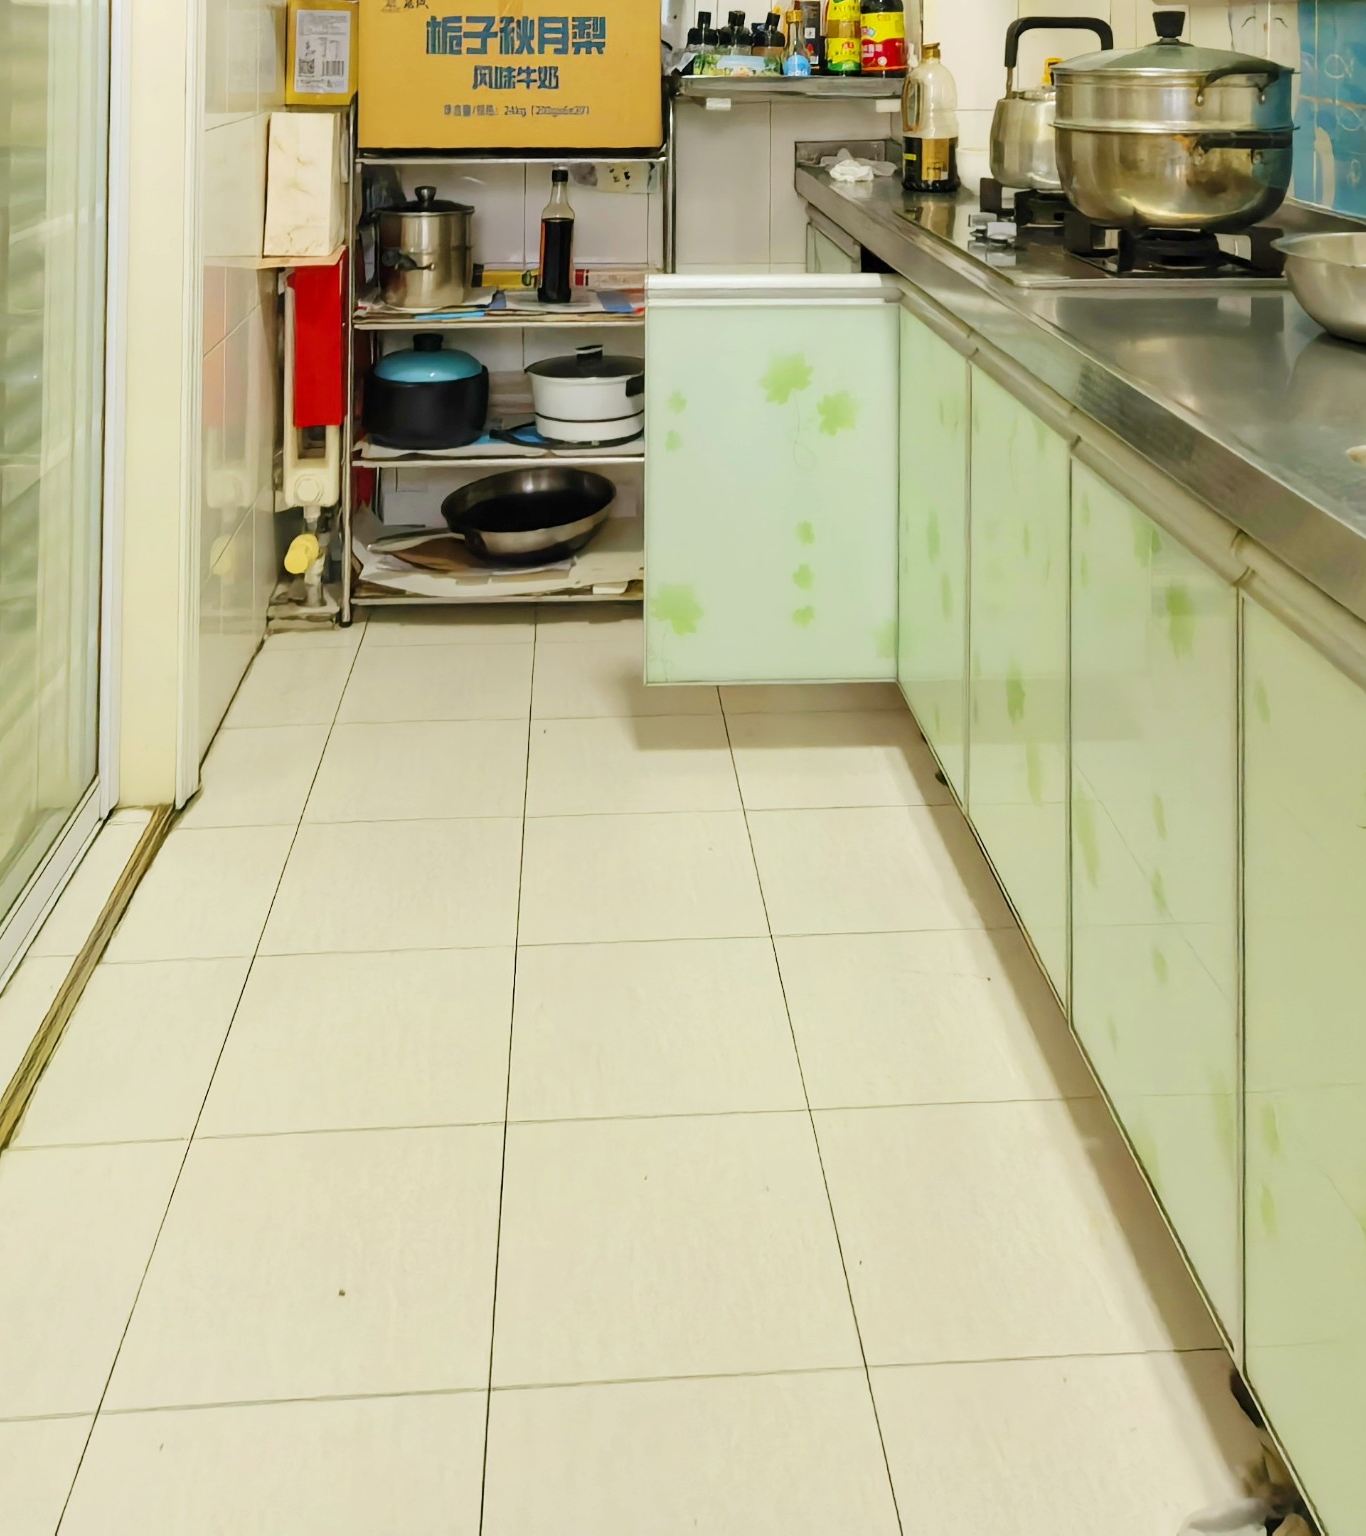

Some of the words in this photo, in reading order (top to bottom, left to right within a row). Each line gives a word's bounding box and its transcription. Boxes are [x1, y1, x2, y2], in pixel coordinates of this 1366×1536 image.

[426, 15, 606, 55] 栀子秋月梨
[472, 65, 560, 90] 风味牛奶
